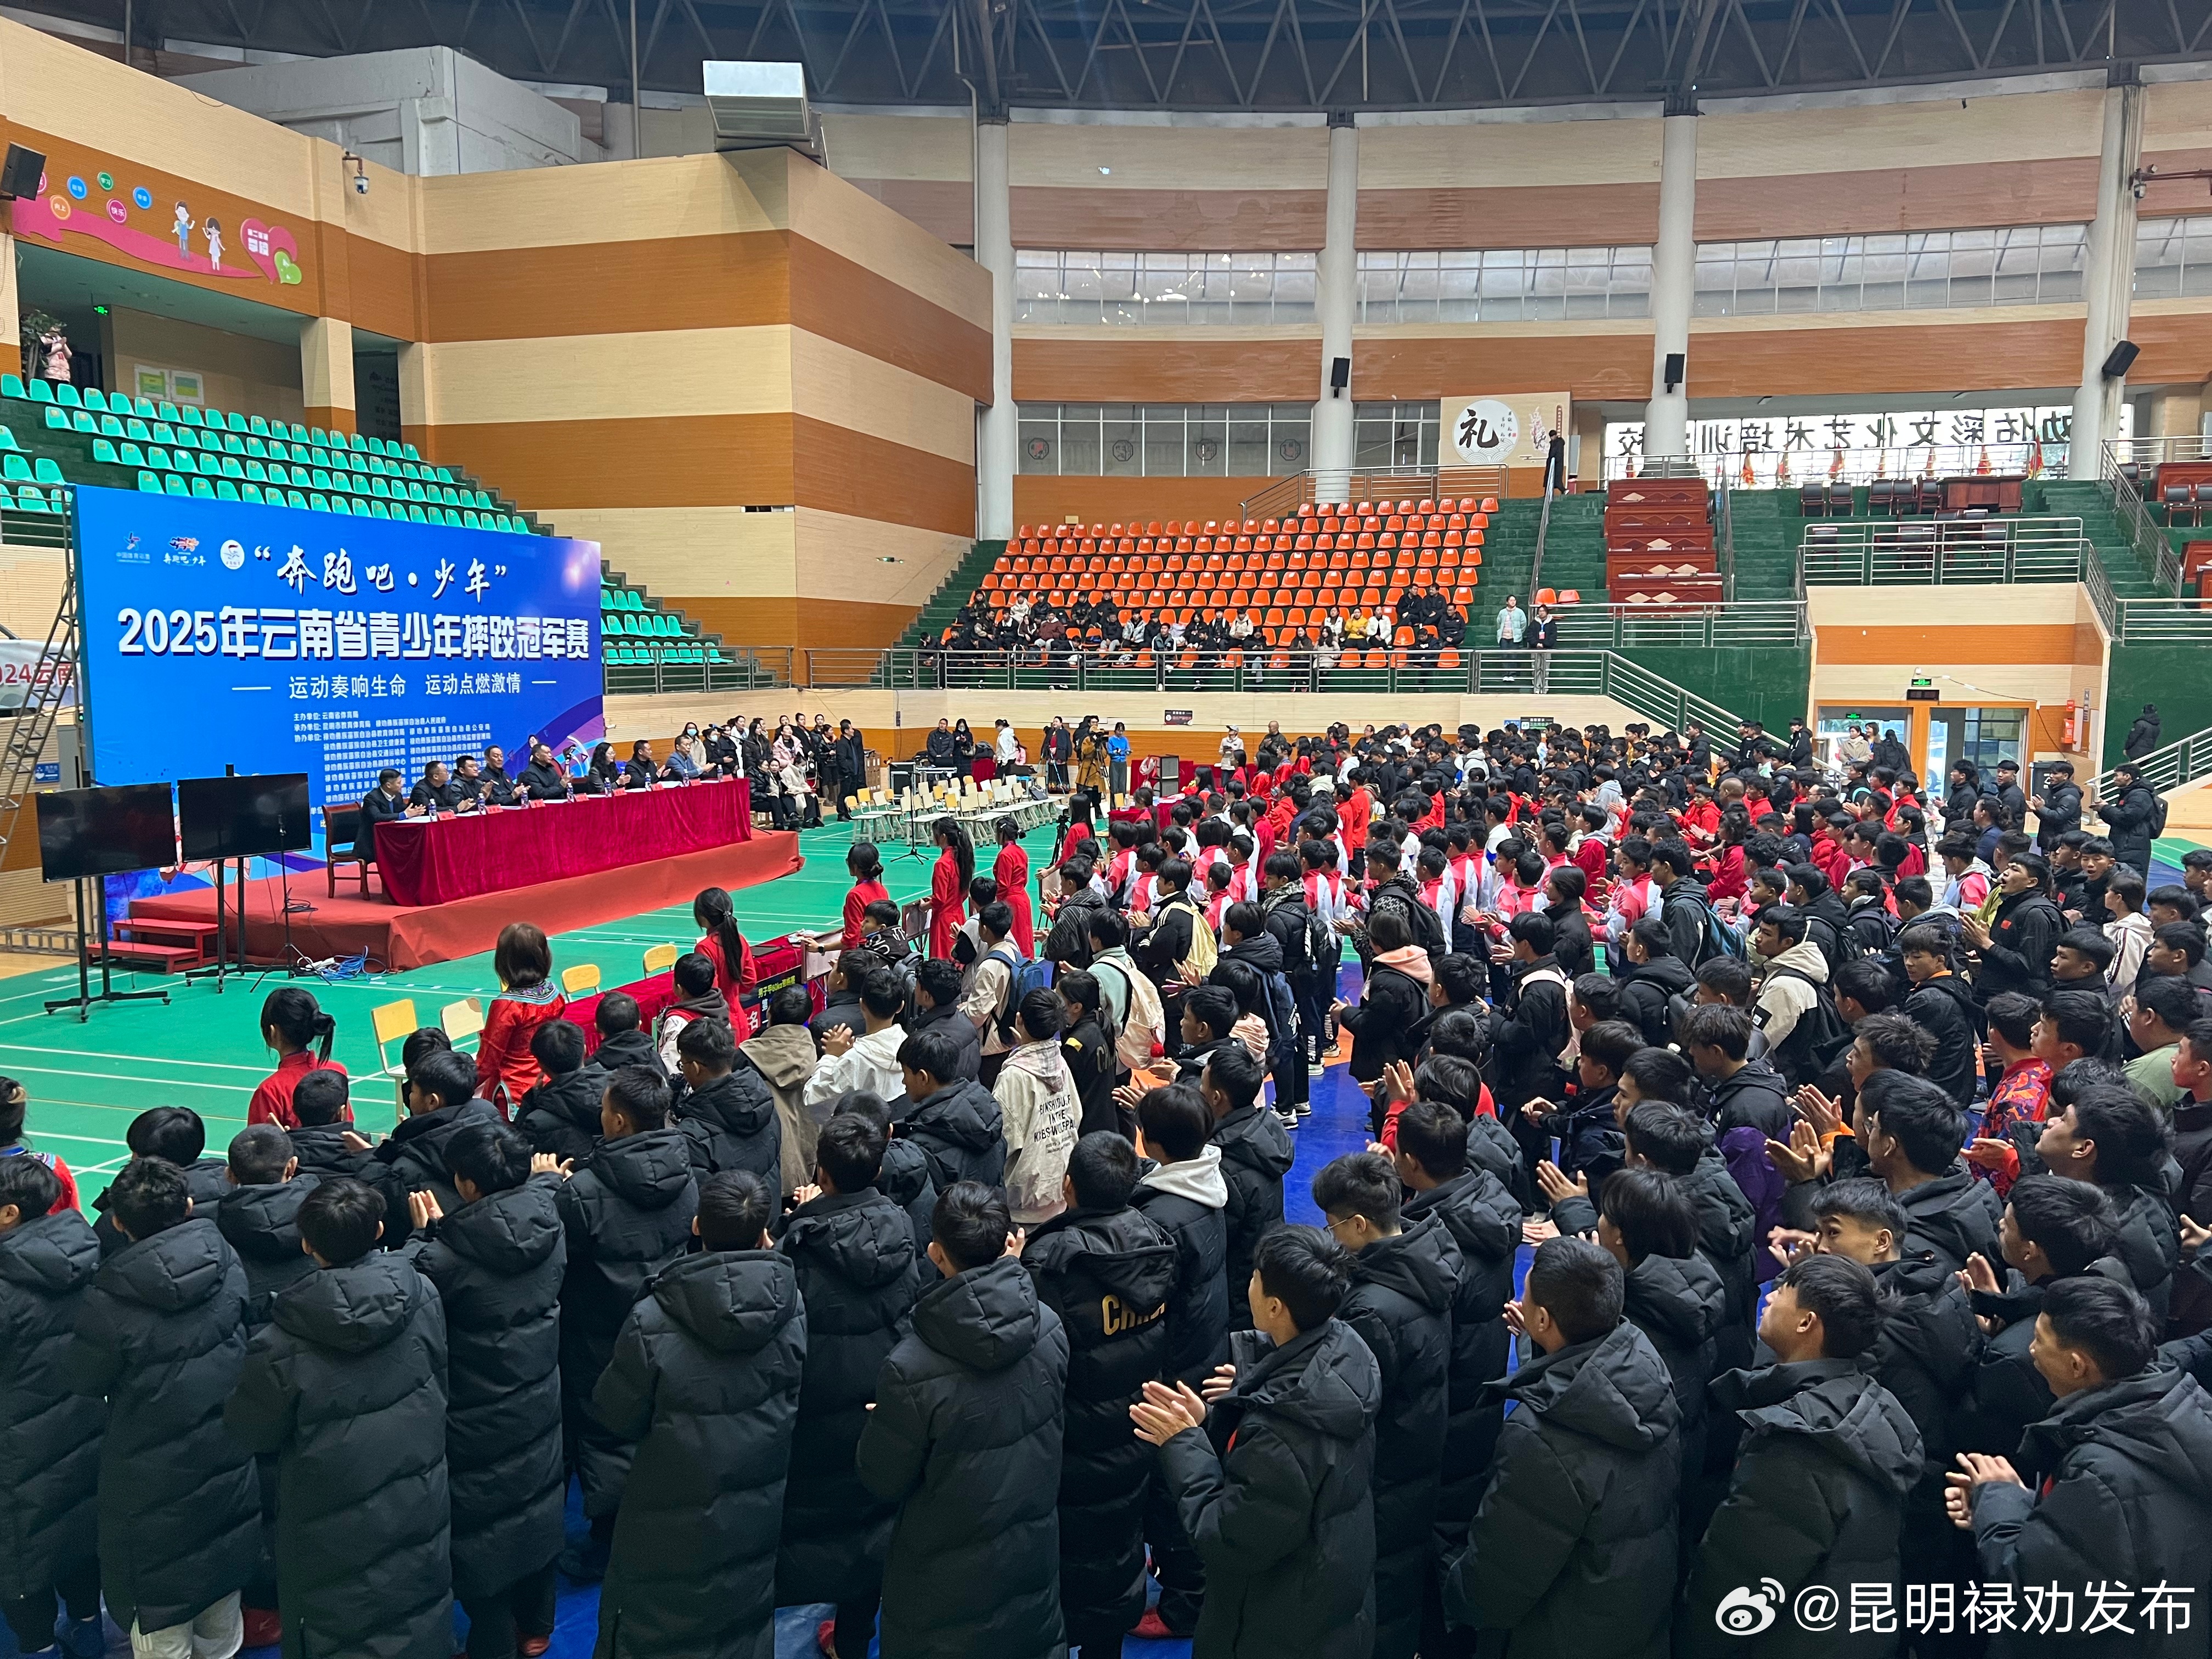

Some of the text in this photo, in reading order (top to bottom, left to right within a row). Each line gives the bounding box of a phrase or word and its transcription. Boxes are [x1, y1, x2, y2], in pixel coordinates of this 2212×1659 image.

[111, 207, 125, 217] 快乐
[1459, 408, 1499, 449] 礼
[117, 605, 590, 659] 2025年云南省青少年摔跤冠军赛
[289, 672, 521, 699] 运动奏响生命 运动点燃激情
[1307, 1035, 1316, 1062] CHINA
